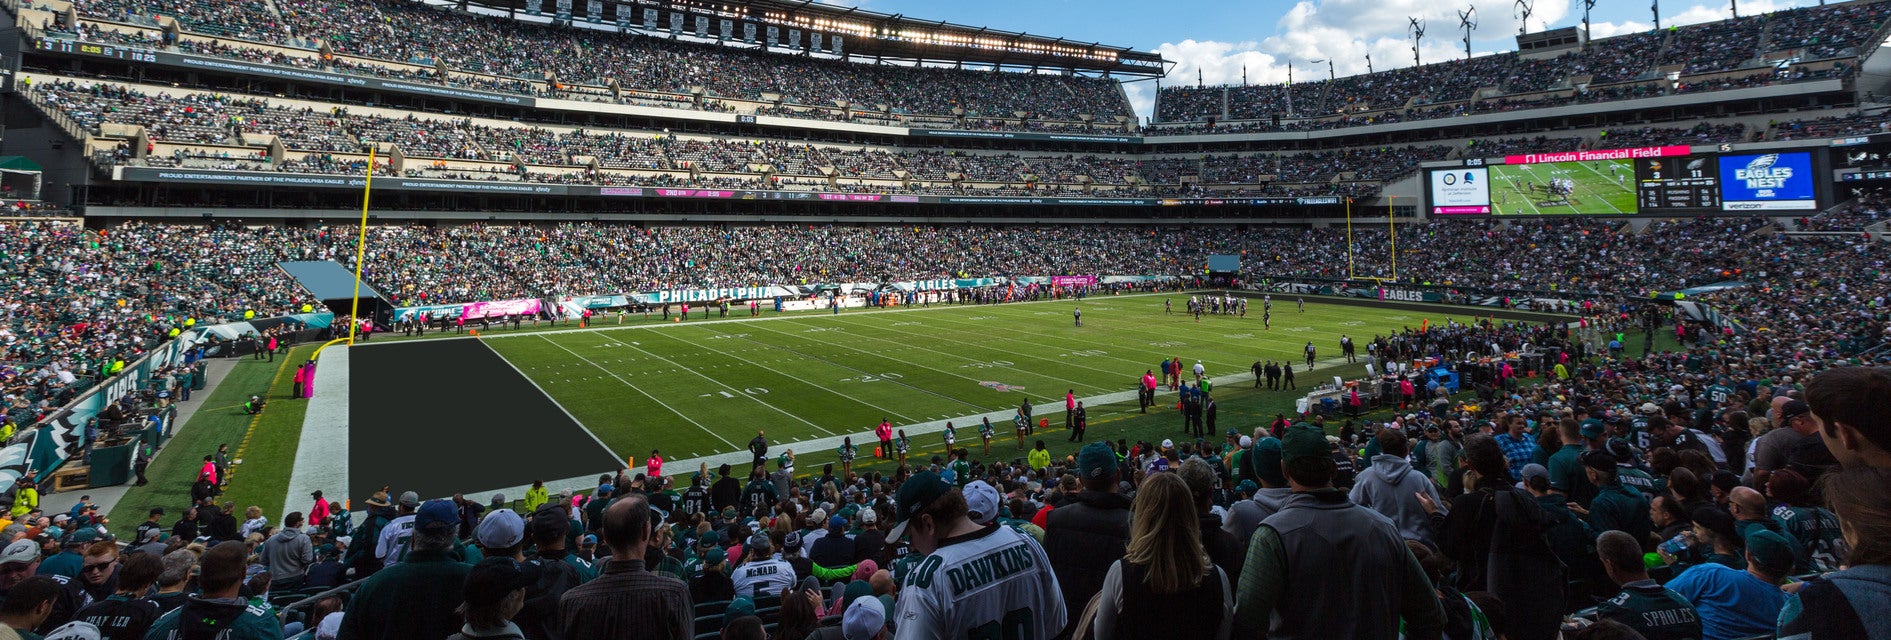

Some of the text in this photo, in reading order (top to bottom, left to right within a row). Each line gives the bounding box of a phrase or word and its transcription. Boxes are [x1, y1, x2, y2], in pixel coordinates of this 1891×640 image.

[44, 42, 52, 50] 3
[61, 43, 73, 52] 11
[81, 45, 102, 54] 0:05
[132, 52, 142, 60] 10
[143, 54, 156, 62] 25
[204, 61, 250, 70] ENTERTAINMENT
[250, 66, 273, 74] PARTNER
[292, 71, 326, 80] PHILADELPHIA
[347, 77, 366, 85] xfinity
[740, 115, 754, 123] 0:05
[1538, 147, 1662, 163] Lincoln Financial Field
[184, 172, 236, 181] ENTERTAINMENT
[1653, 171, 1660, 179] 3
[1691, 170, 1702, 178] 11
[1734, 167, 1793, 180] EAGLES
[347, 179, 368, 187] xfinit
[1746, 178, 1786, 189] NEST
[659, 286, 773, 303] PHILADELPHIA
[1384, 289, 1423, 301] EAGLES
[1711, 390, 1727, 403] 50
[686, 499, 702, 514] 81
[746, 565, 778, 578] McNABB
[946, 544, 1035, 596] DAWKINS
[1642, 607, 1696, 627] SPROLES
